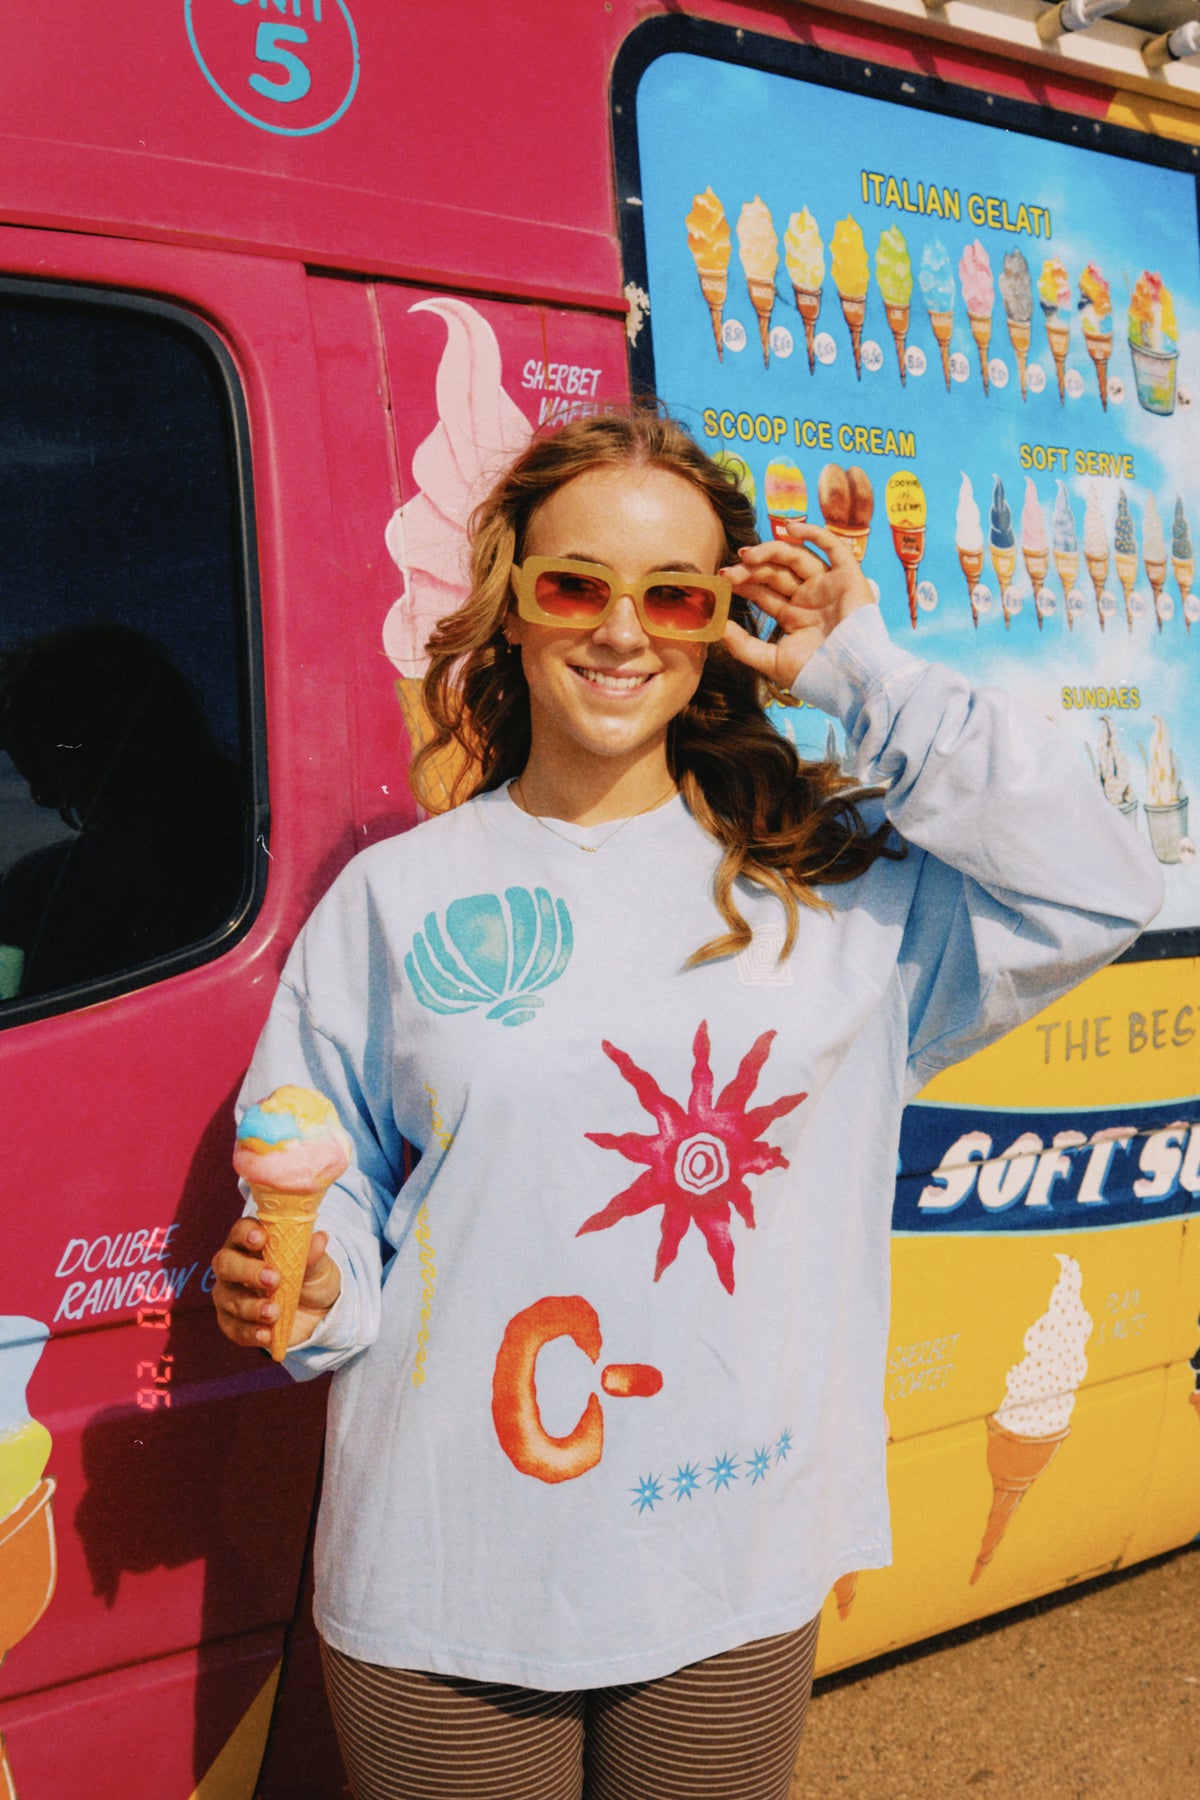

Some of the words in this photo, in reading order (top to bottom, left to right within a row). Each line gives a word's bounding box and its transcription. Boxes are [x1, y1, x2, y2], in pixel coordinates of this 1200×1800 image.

[248, 22, 311, 103] 5
[860, 170, 961, 222] ITALIAN
[967, 193, 1051, 239] GELATI
[521, 359, 602, 397] SHERBET
[703, 408, 788, 445] SCOOP
[794, 418, 833, 450] ICE
[838, 424, 917, 458] CREAM
[1020, 443, 1070, 474] SOFT
[1074, 450, 1136, 479] SERVE
[1061, 686, 1141, 710] SUNDAES
[1036, 1015, 1112, 1064] THE
[1128, 1005, 1200, 1054] BES
[917, 1127, 1138, 1214] SOFT
[55, 1224, 180, 1278] DOUBLE
[53, 1261, 199, 1323] RAINBOW
